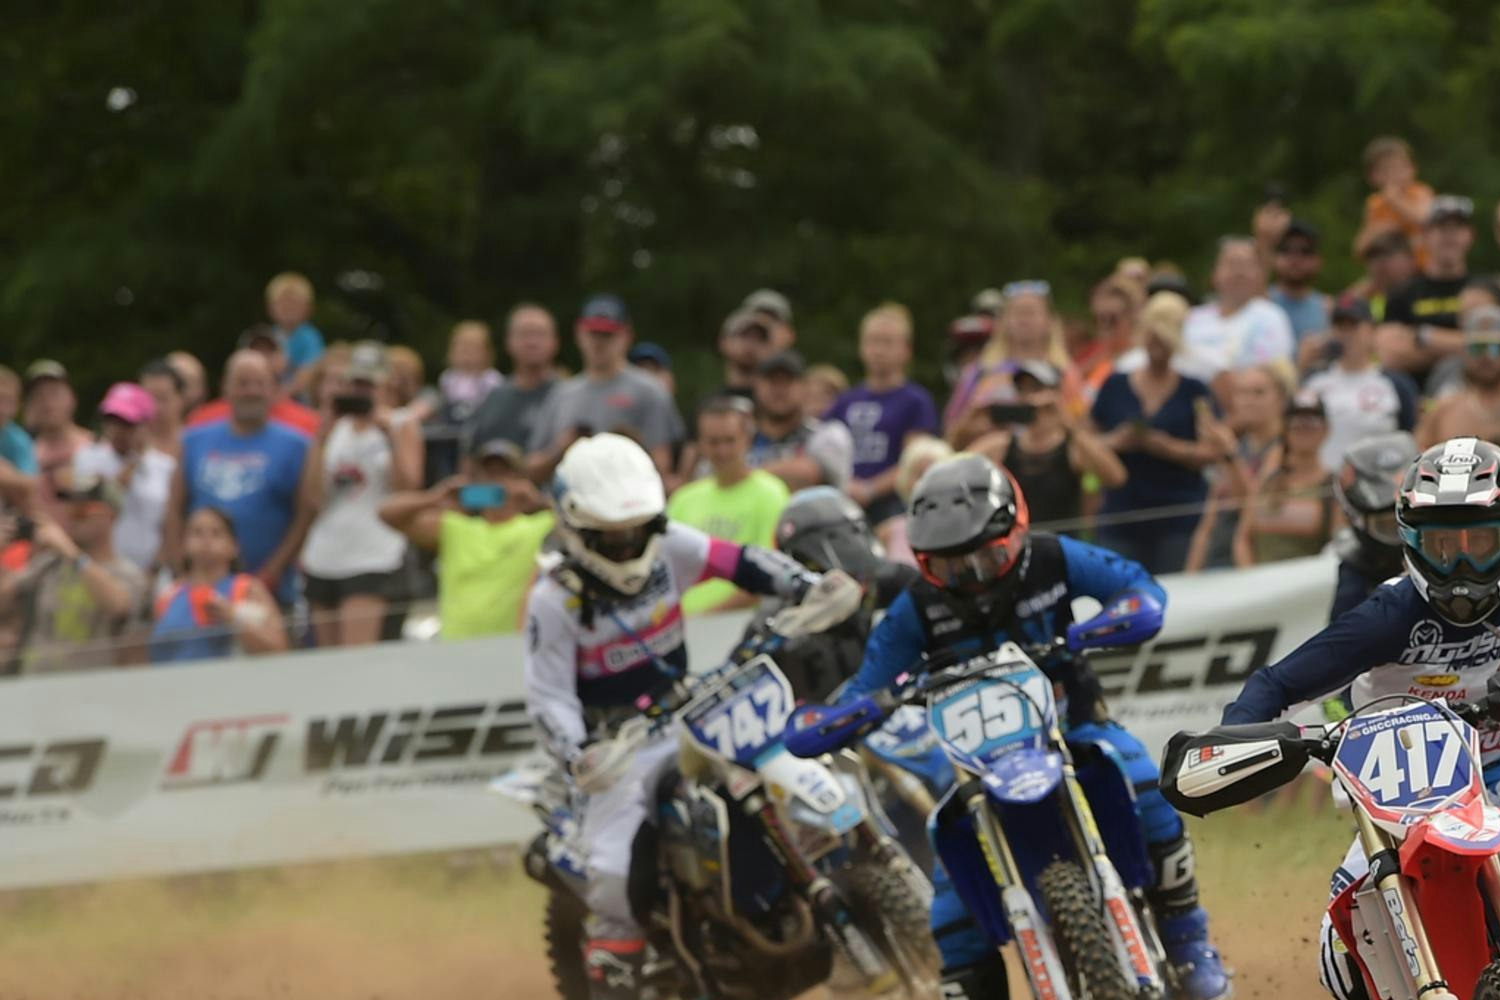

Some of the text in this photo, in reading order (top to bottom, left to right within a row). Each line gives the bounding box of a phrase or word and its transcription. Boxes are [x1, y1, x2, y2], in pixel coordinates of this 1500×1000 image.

[1084, 626, 1279, 698] ECO
[304, 700, 538, 774] WISE
[703, 674, 783, 762] 742
[1358, 719, 1465, 803] 417
